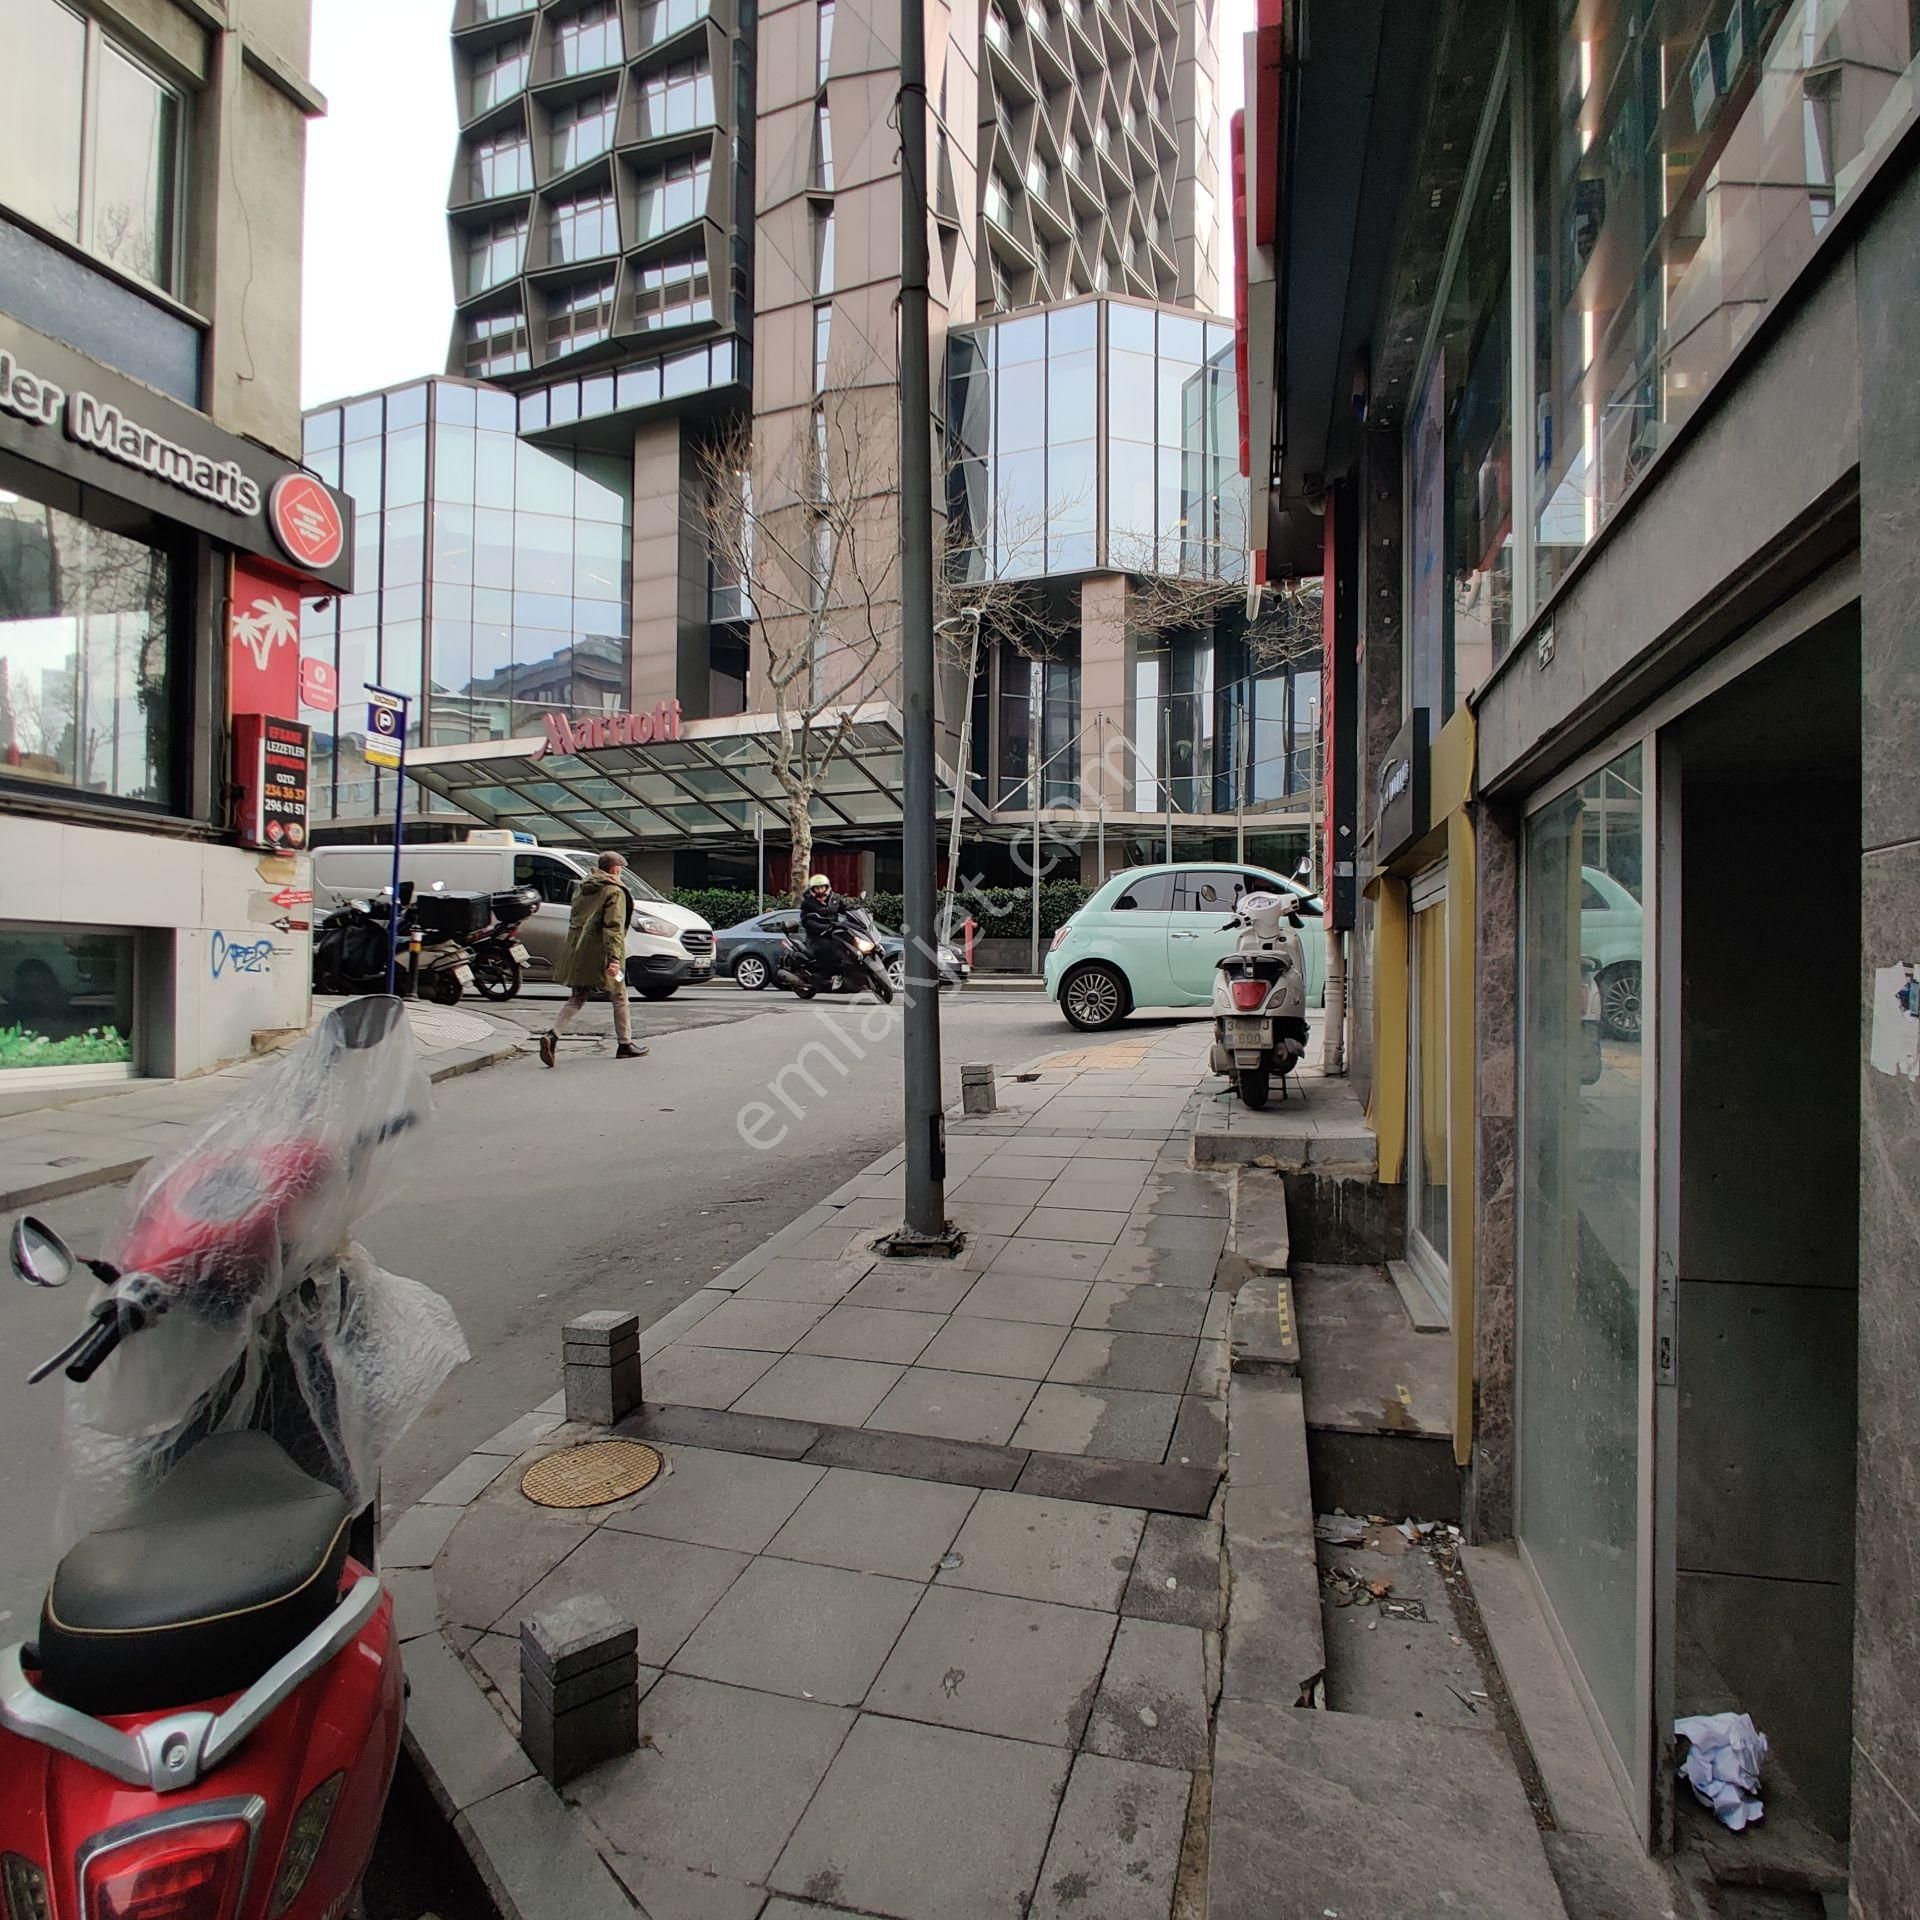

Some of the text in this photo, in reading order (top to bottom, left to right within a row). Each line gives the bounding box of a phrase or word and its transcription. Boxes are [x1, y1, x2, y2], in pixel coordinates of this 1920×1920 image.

[69, 392, 260, 517] Marmaris
[379, 712, 392, 729] P
[530, 699, 682, 761] Marriott
[266, 741, 305, 757] LEZZETLER
[276, 773, 295, 785] 0212
[265, 799, 282, 812] 296
[1239, 1033, 1261, 1045] 600
